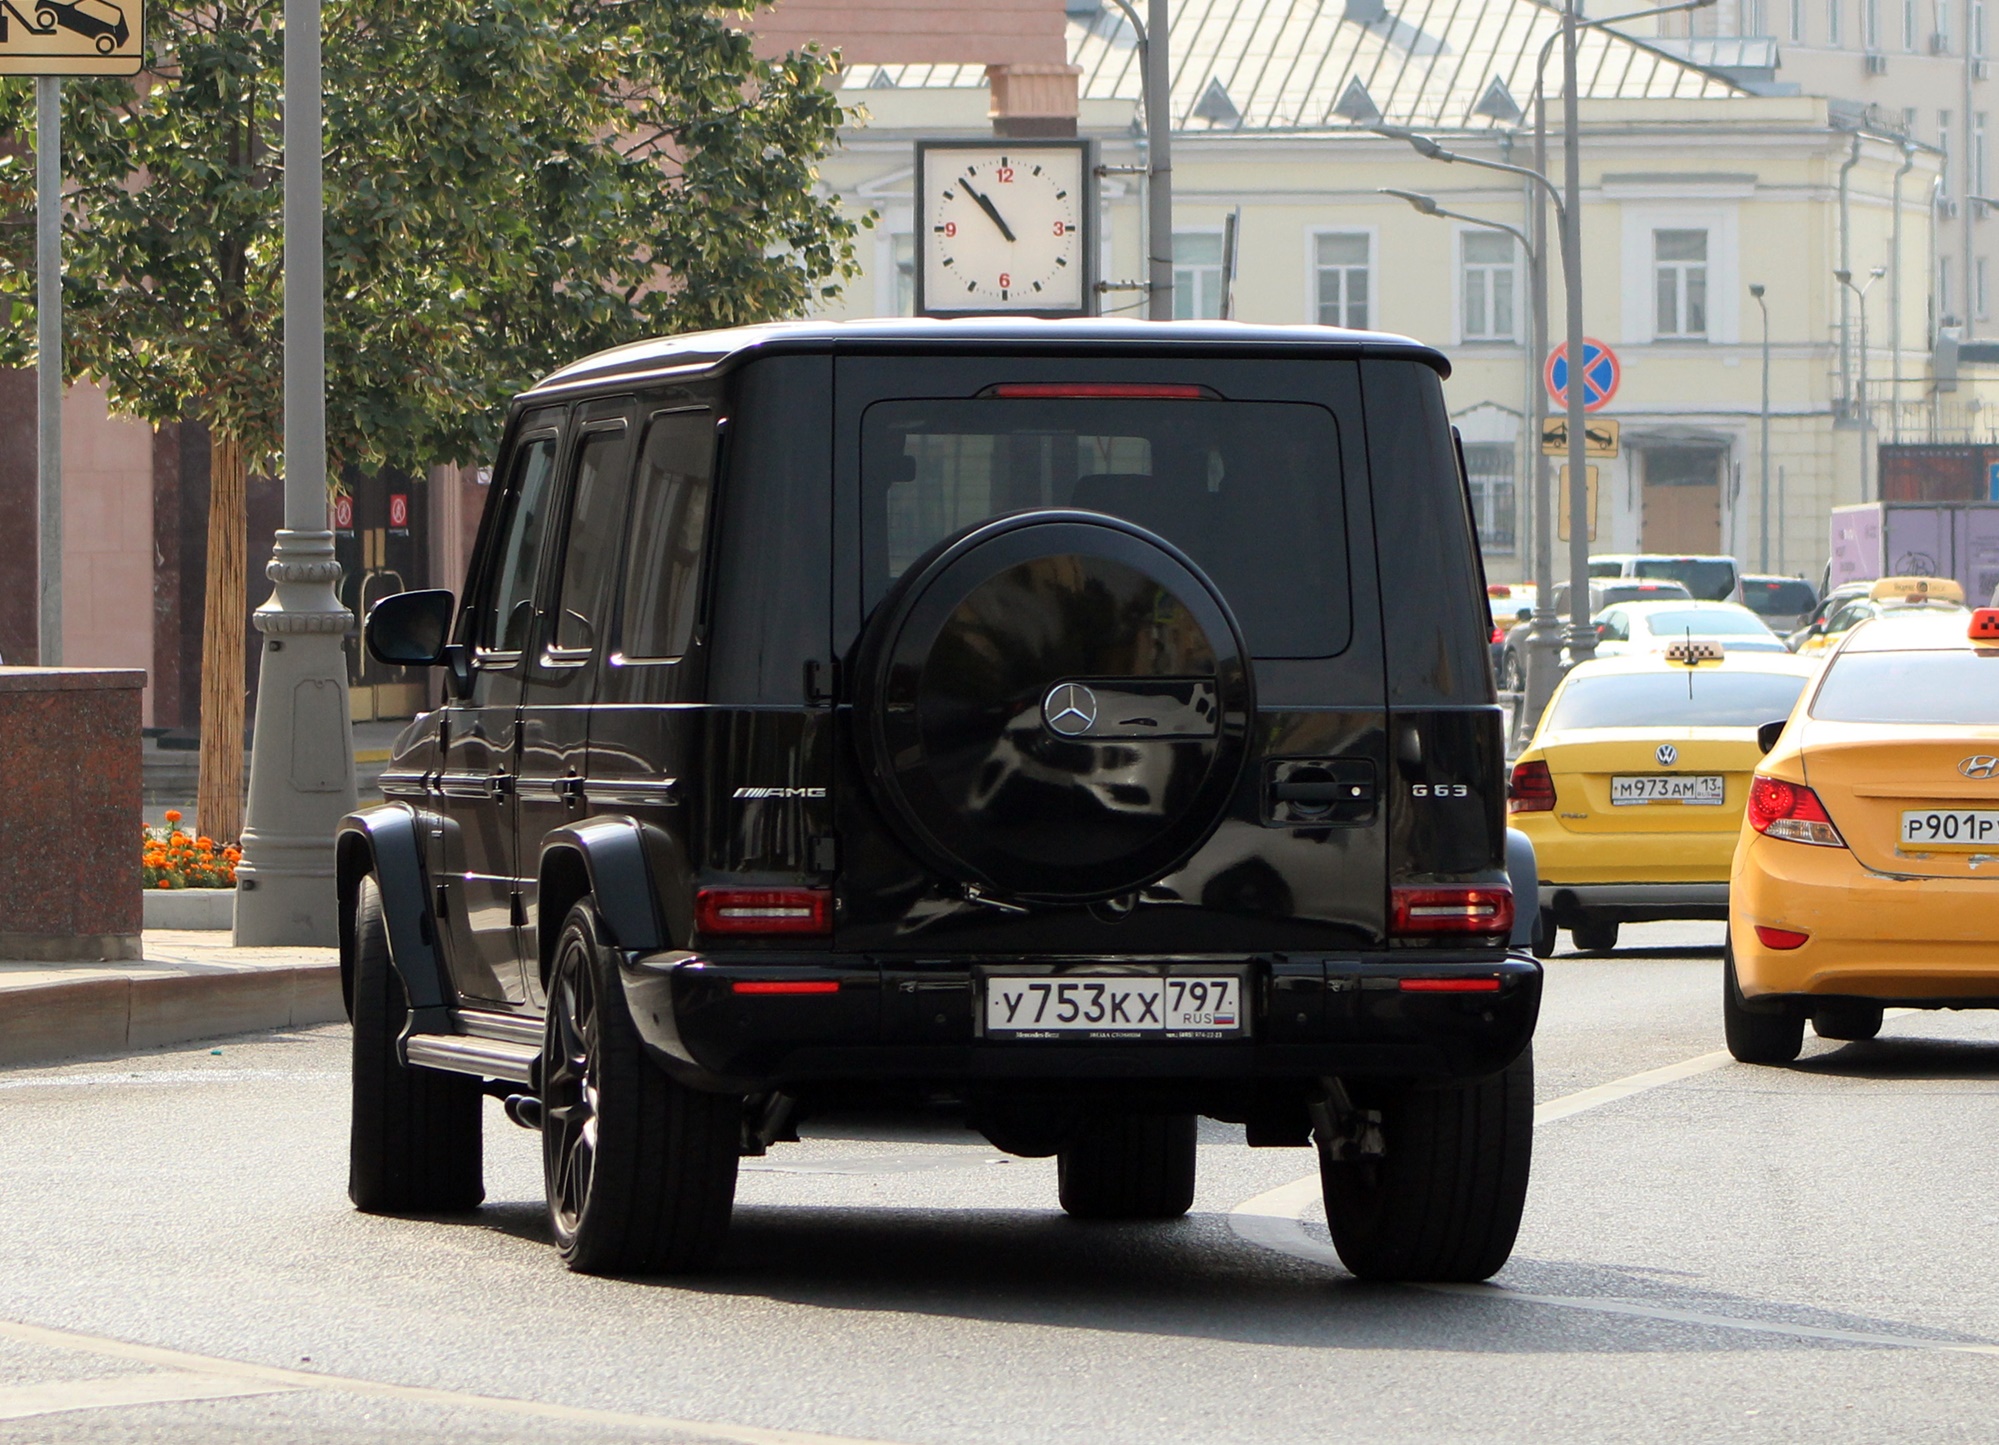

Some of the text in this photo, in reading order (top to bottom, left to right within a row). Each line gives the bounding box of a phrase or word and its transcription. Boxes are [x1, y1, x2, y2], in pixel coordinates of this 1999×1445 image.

[996, 168, 1014, 183] 12
[945, 222, 957, 237] 9
[1053, 221, 1064, 236] 3
[999, 273, 1011, 288] 6
[1412, 784, 1468, 797] G 63
[1701, 778, 1718, 791] 13
[1908, 814, 1999, 839] Р901Р
[1168, 981, 1229, 1012] 797
[1183, 1012, 1213, 1025] RUS
